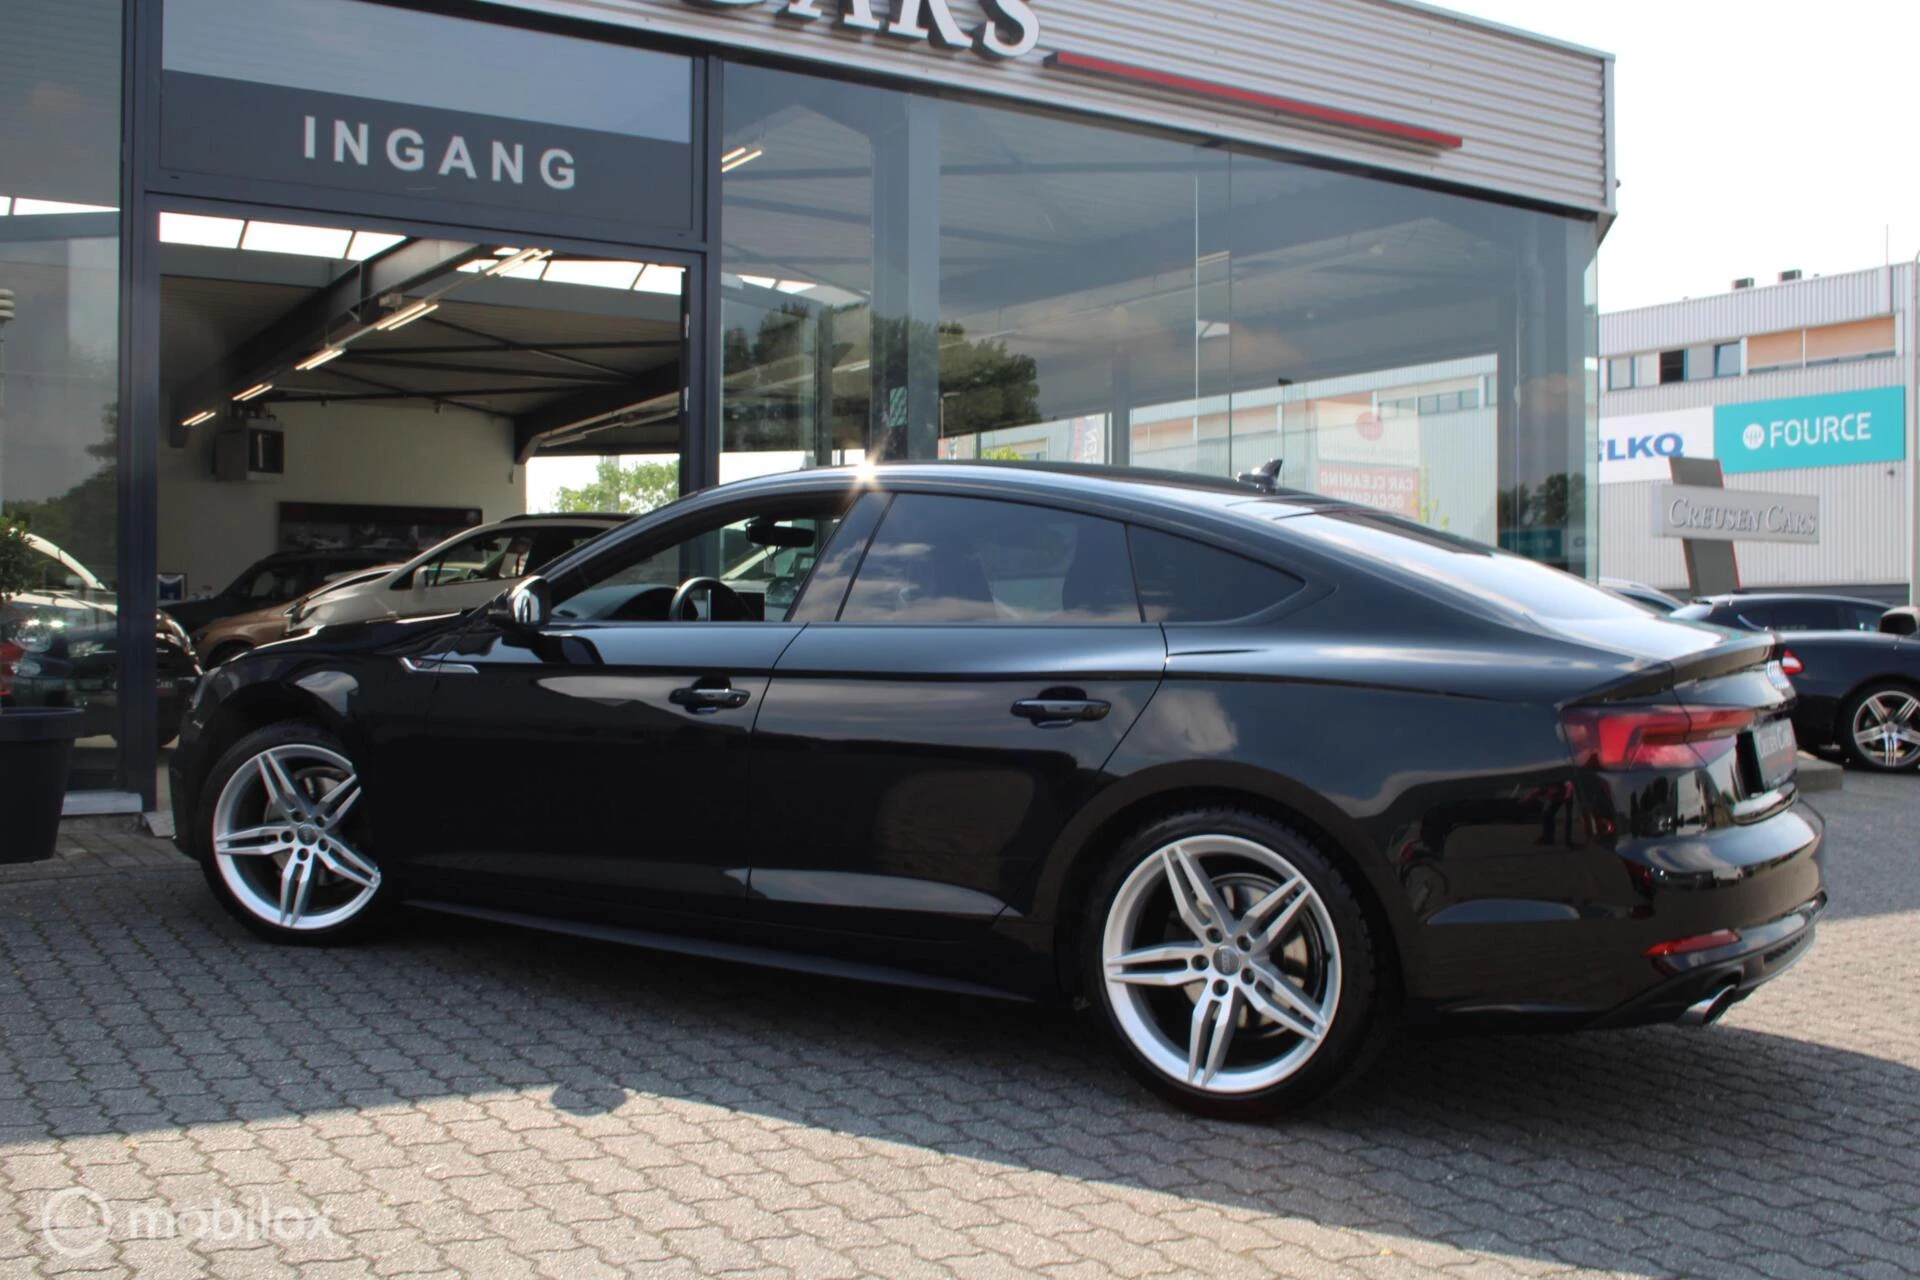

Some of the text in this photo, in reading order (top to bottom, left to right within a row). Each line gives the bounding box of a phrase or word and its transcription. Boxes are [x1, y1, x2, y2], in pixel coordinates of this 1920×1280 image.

[304, 115, 575, 190] INGANG
[1770, 412, 1872, 448] FOURCE
[1668, 497, 1816, 535] CREUSEN CARS
